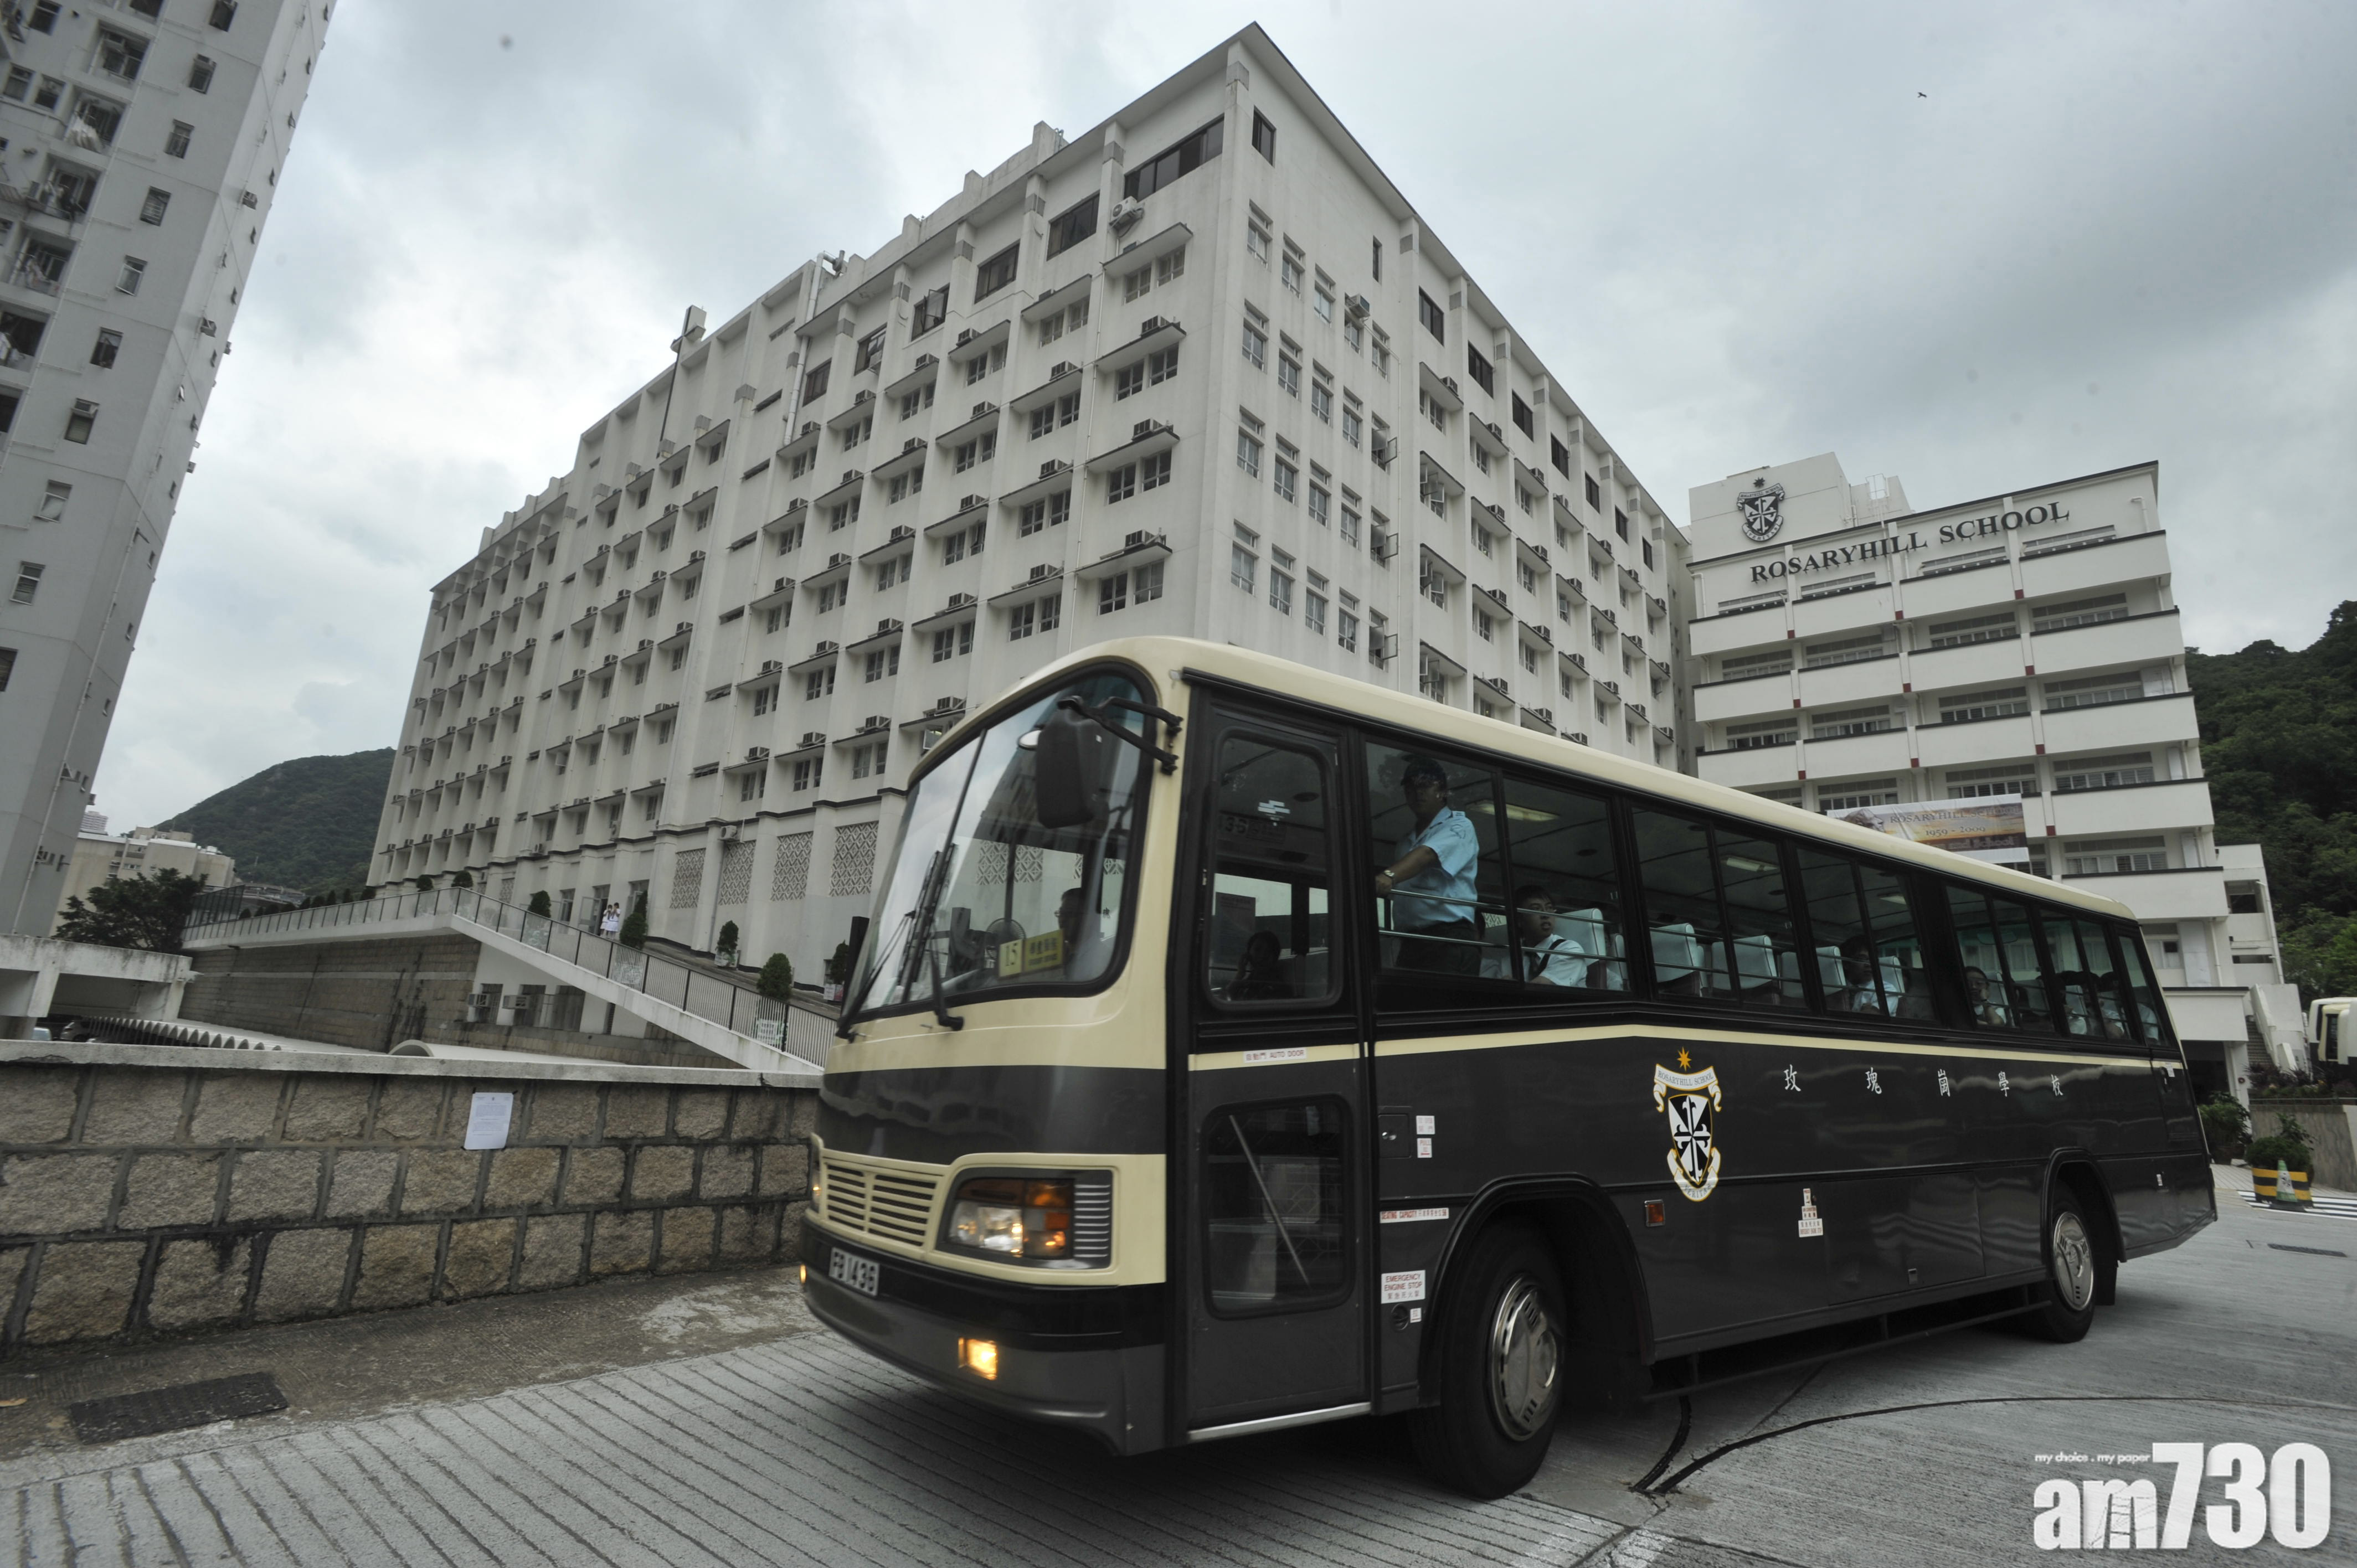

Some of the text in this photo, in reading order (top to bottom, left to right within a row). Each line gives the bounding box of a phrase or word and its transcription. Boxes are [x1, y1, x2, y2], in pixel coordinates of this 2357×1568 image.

[1750, 502, 2070, 583] ROSARYHILL SCHOOL
[1890, 811, 1967, 823] ROSARYHILL
[1926, 829, 1948, 837] 1959
[1005, 943, 1017, 966] 15
[1658, 1070, 1713, 1086] ROSARYHILL SCHOOL
[1386, 1273, 1421, 1282] EMERGENCY
[1384, 1283, 1406, 1291] ENGINE
